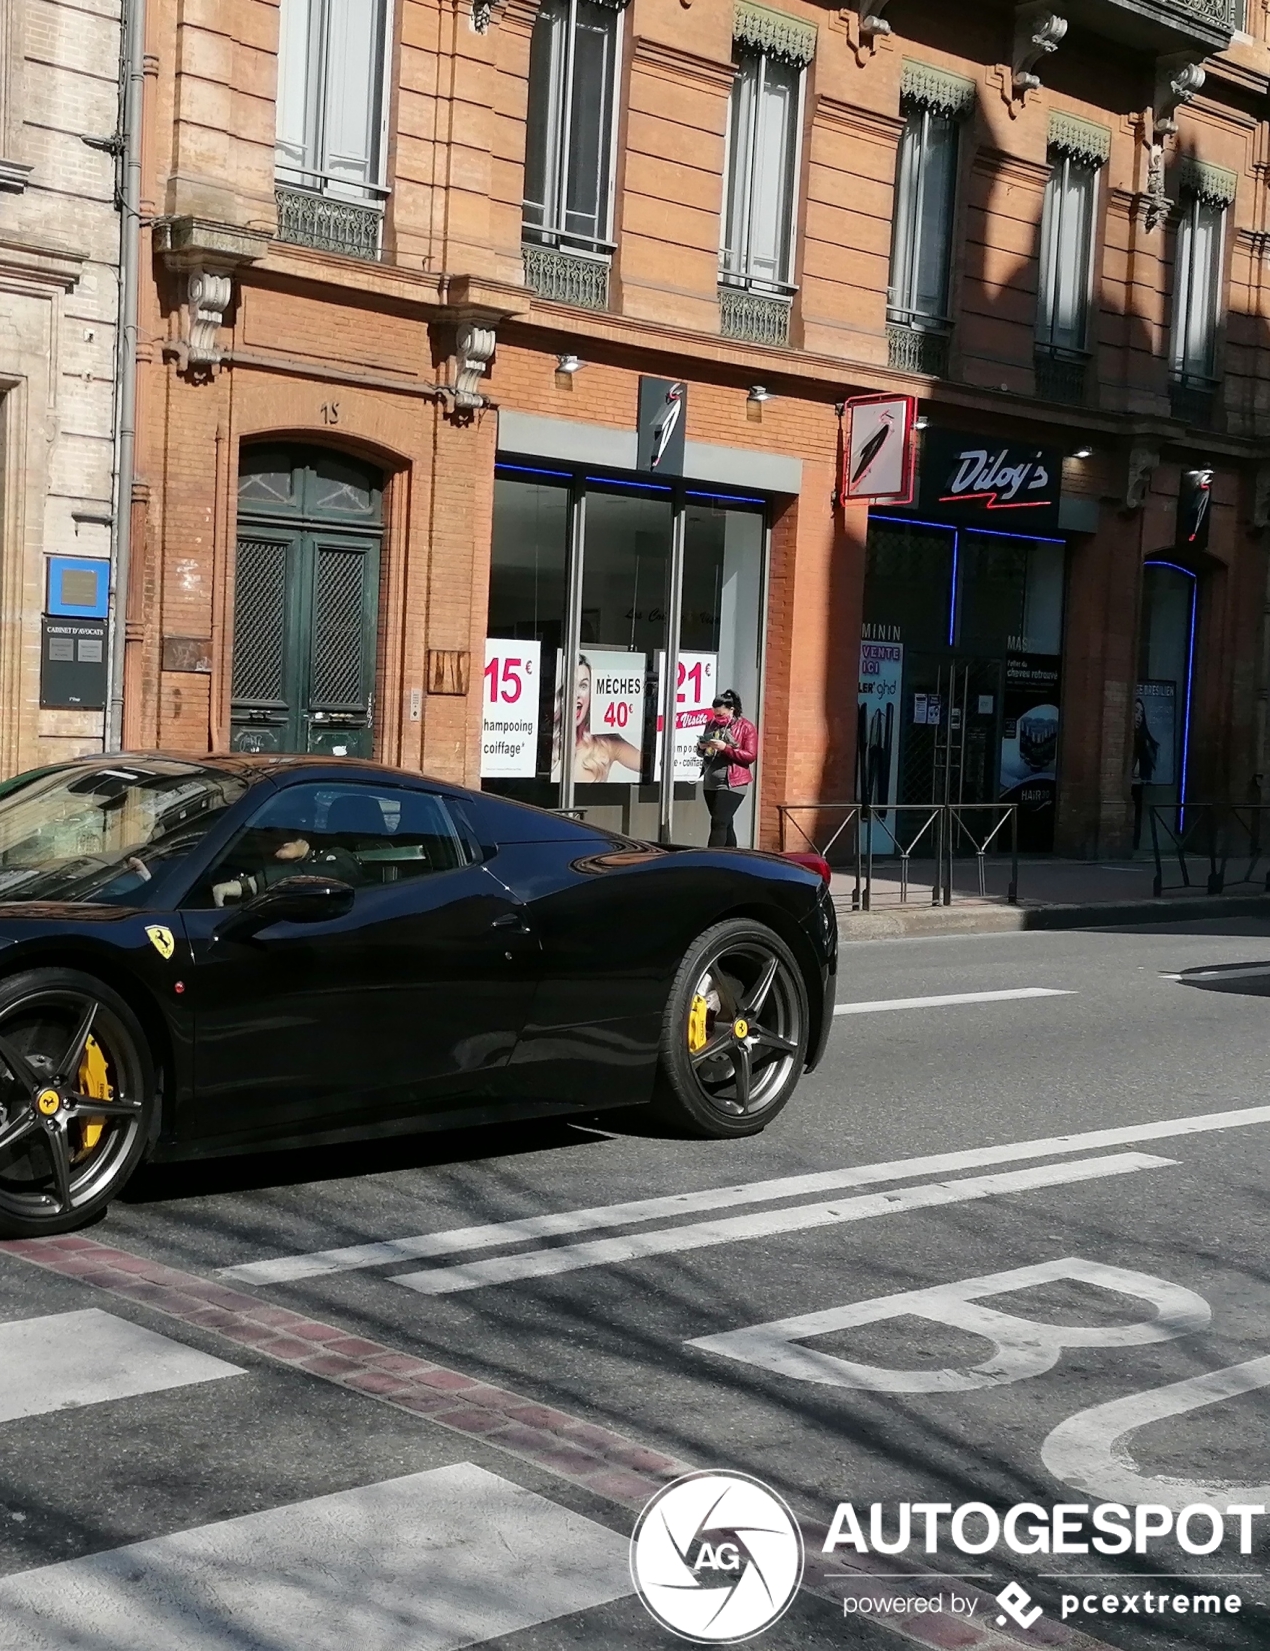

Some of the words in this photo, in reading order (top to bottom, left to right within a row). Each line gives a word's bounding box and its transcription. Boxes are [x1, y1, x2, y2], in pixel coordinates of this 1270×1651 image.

[320, 401, 340, 425] 15
[951, 448, 1049, 500] Diloy's
[46, 626, 72, 635] CABINET
[862, 644, 901, 660] VENTE
[862, 660, 880, 674] ICI
[596, 674, 641, 694] MÈCHES
[876, 679, 897, 700] ghd
[483, 718, 533, 735] hampooing
[681, 712, 708, 728] Visite
